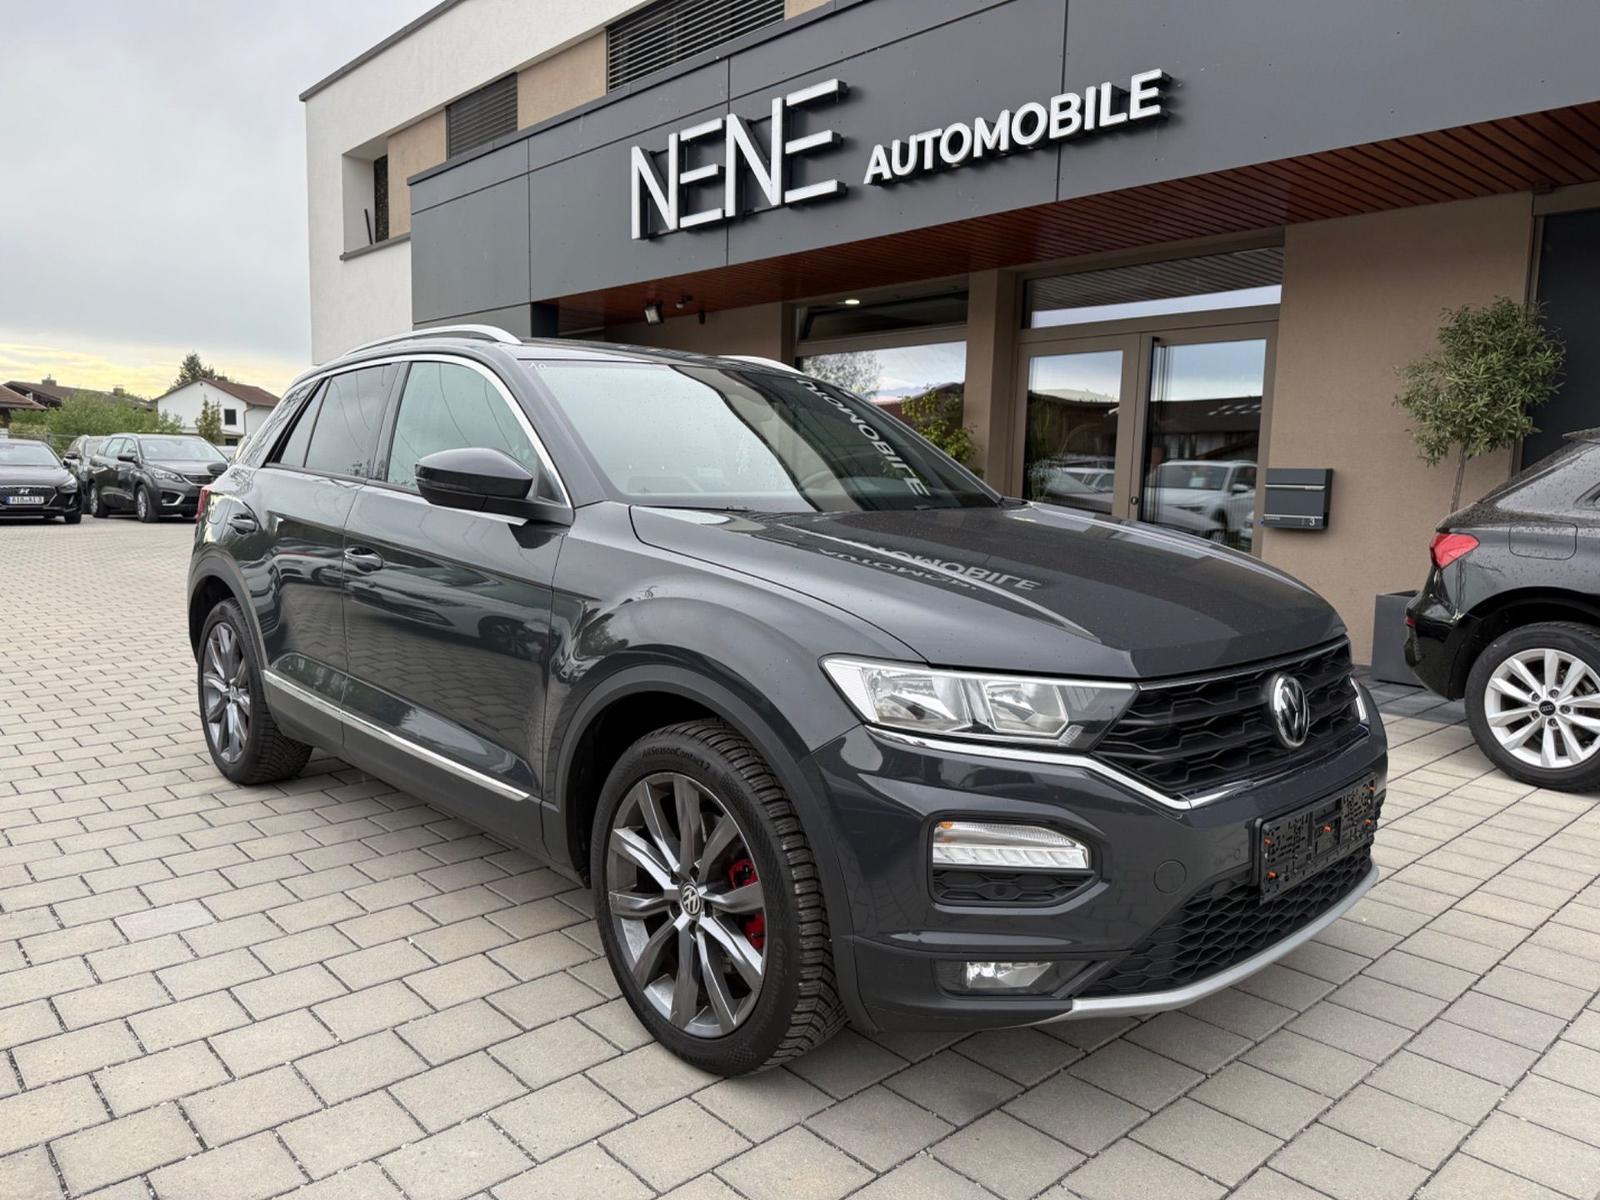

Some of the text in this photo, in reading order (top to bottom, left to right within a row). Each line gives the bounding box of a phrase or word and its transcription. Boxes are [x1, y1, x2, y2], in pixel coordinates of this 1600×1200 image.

[631, 69, 1164, 239] NENE AUTOMOBILE
[1309, 517, 1315, 526] 3
